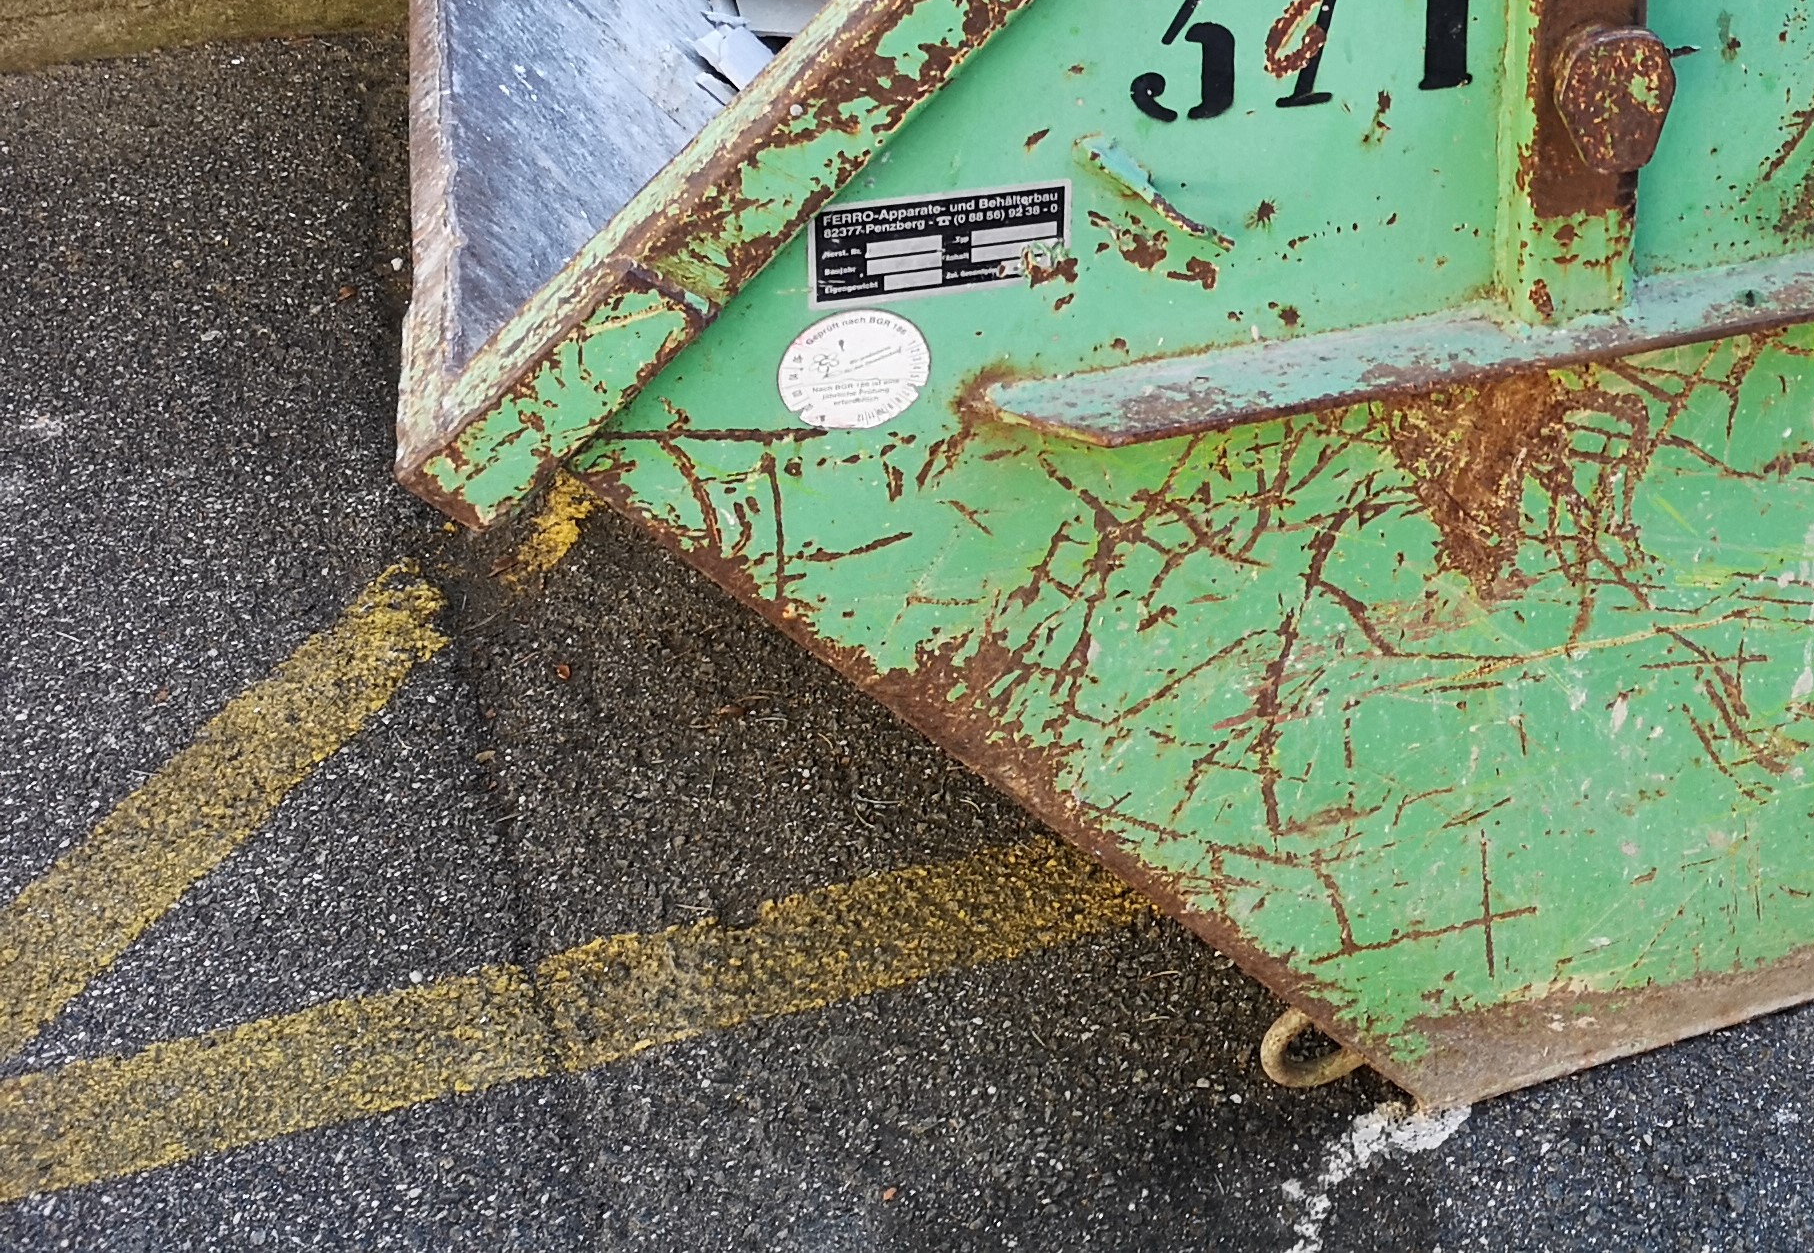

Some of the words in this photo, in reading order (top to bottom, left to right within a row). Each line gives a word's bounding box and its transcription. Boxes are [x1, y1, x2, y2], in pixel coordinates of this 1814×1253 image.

[949, 200, 975, 212] und
[979, 192, 1058, 209] Behälterbau
[823, 226, 862, 239] 82377
[865, 219, 925, 234] Penzberg
[842, 317, 866, 326] nach
[869, 316, 891, 327] BGR
